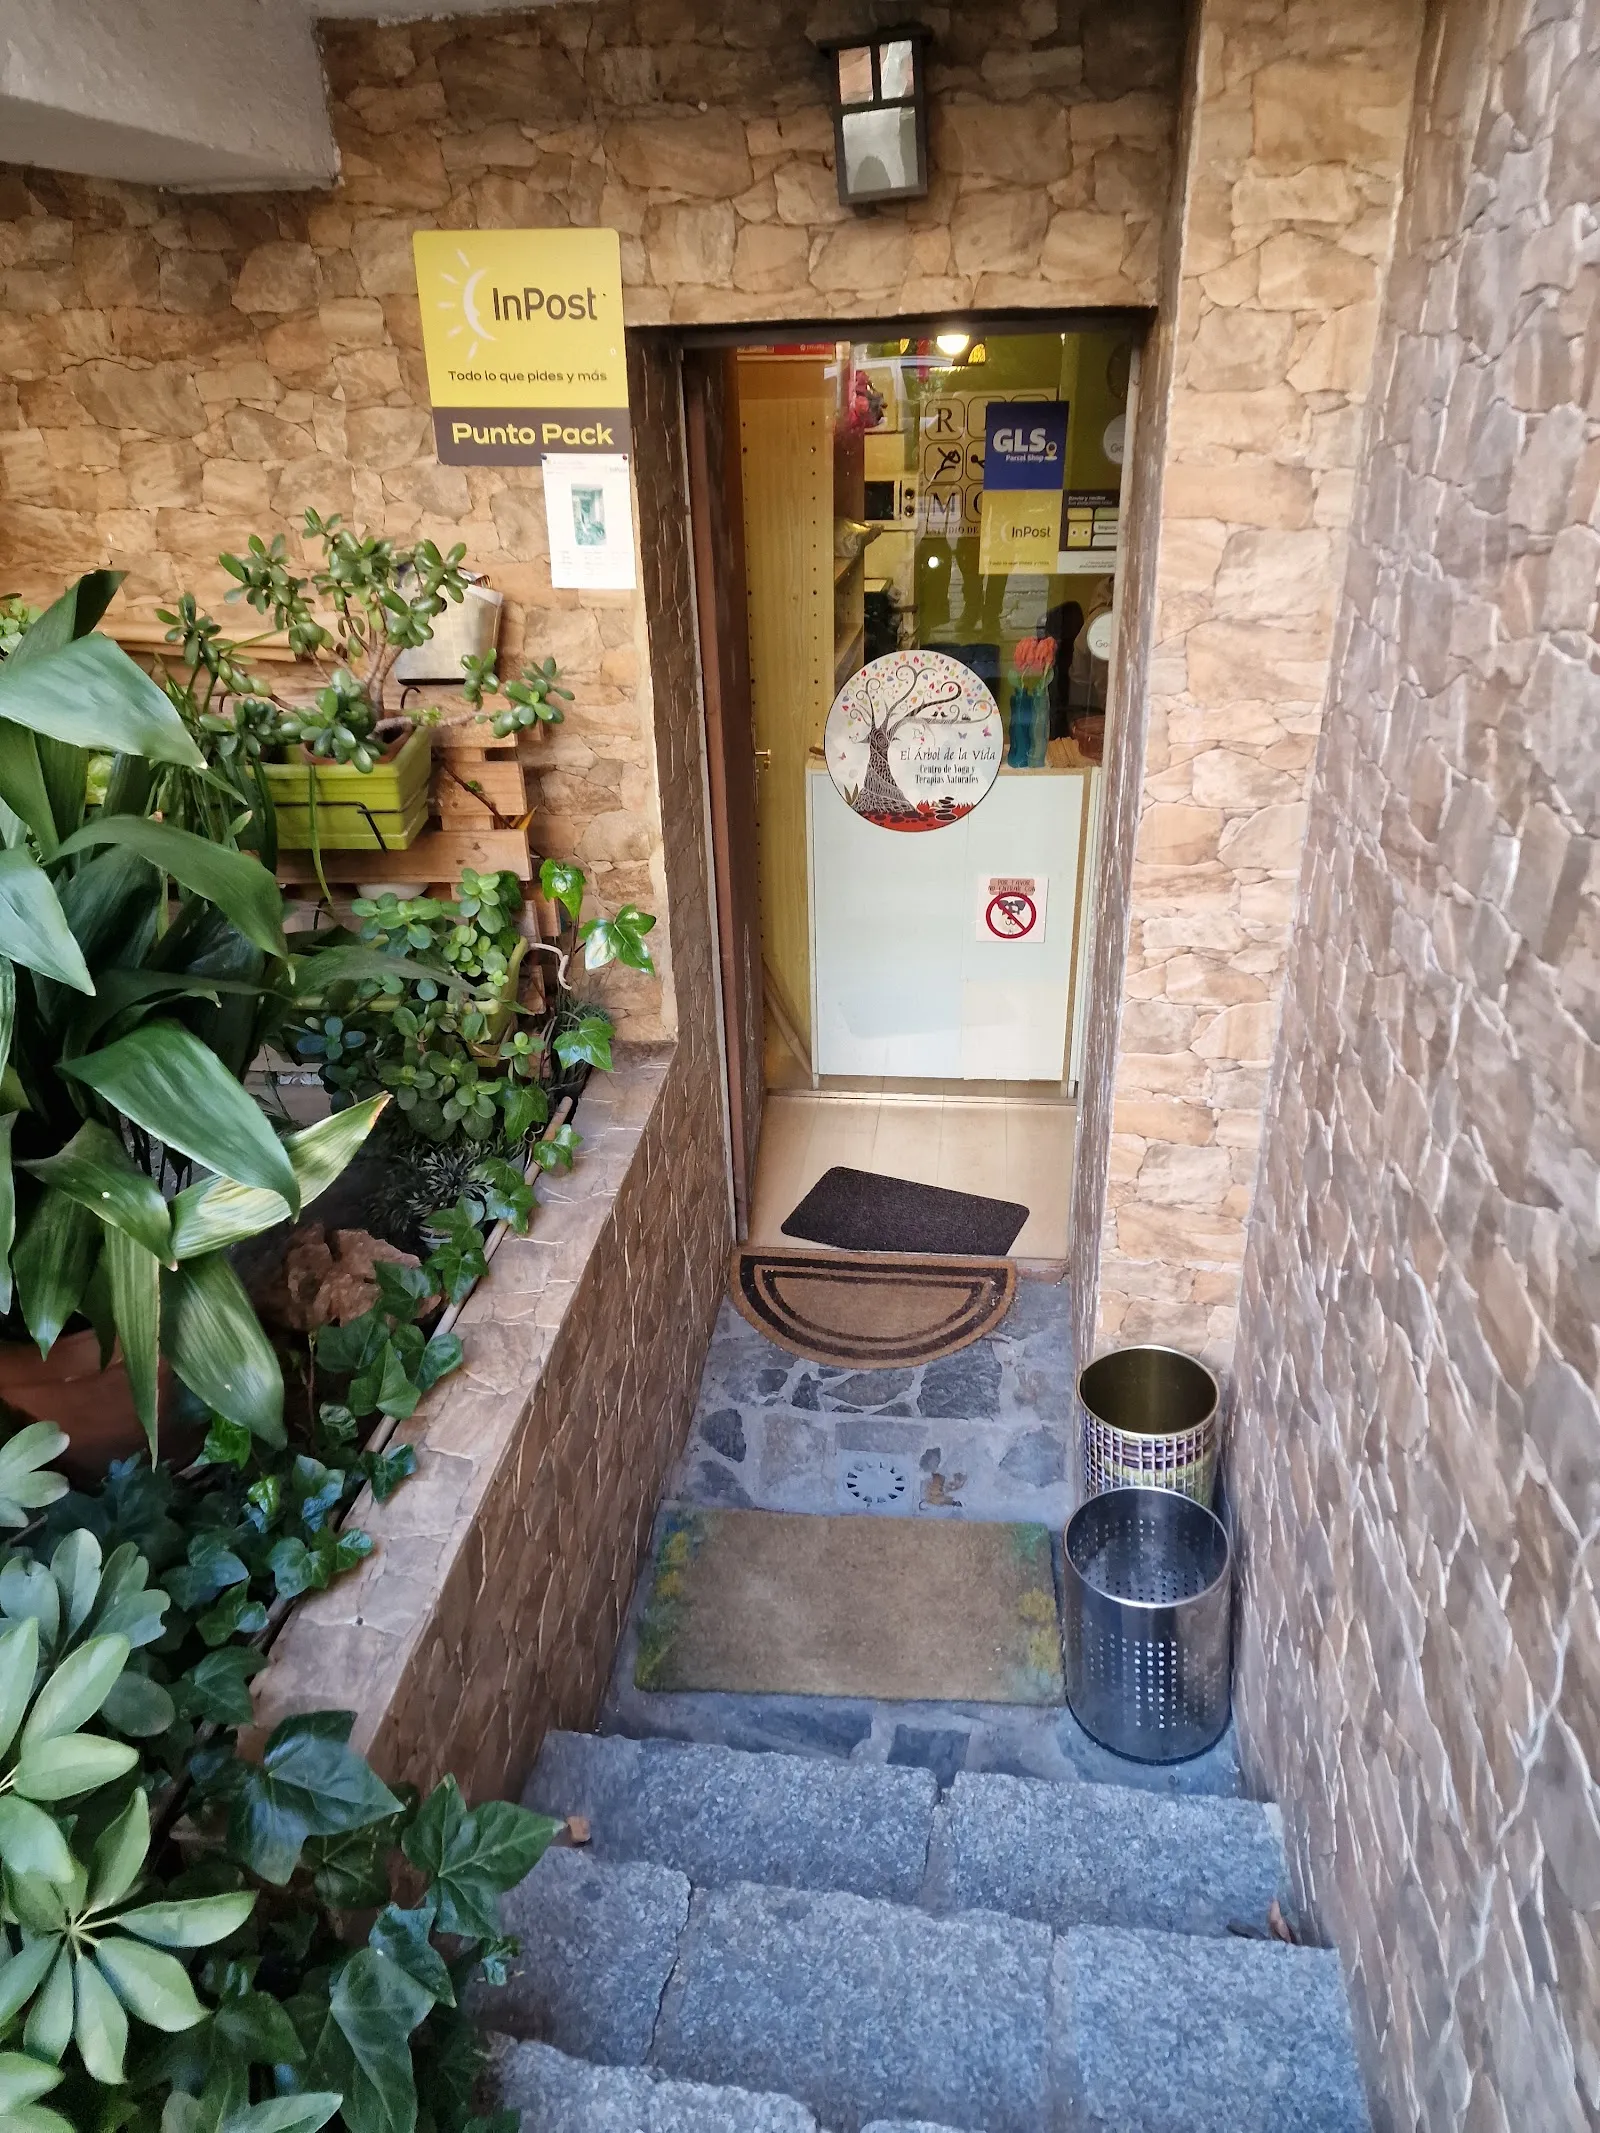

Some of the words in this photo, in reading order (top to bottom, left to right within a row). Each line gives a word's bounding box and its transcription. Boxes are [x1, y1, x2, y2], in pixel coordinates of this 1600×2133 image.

[492, 286, 598, 321] InPost
[448, 370, 482, 381] Todo
[484, 370, 497, 381] lo
[500, 372, 525, 384] que
[527, 370, 564, 383] pides
[567, 373, 574, 383] y
[578, 370, 607, 381] más
[452, 422, 536, 445] Punto
[541, 422, 614, 445] Pack
[992, 427, 1046, 453] GLS
[1005, 454, 1026, 462] Parcel
[1027, 454, 1044, 463] Shop
[1011, 526, 1051, 538] InPost
[900, 747, 911, 761] El
[914, 746, 940, 761] Árbol
[943, 747, 954, 761] de
[958, 747, 968, 761] la
[972, 746, 996, 761] Vida
[919, 764, 942, 773] Centro
[943, 764, 951, 773] de
[953, 764, 970, 775] Yoga
[914, 774, 945, 785] Terapias
[946, 774, 979, 784] Naturales
